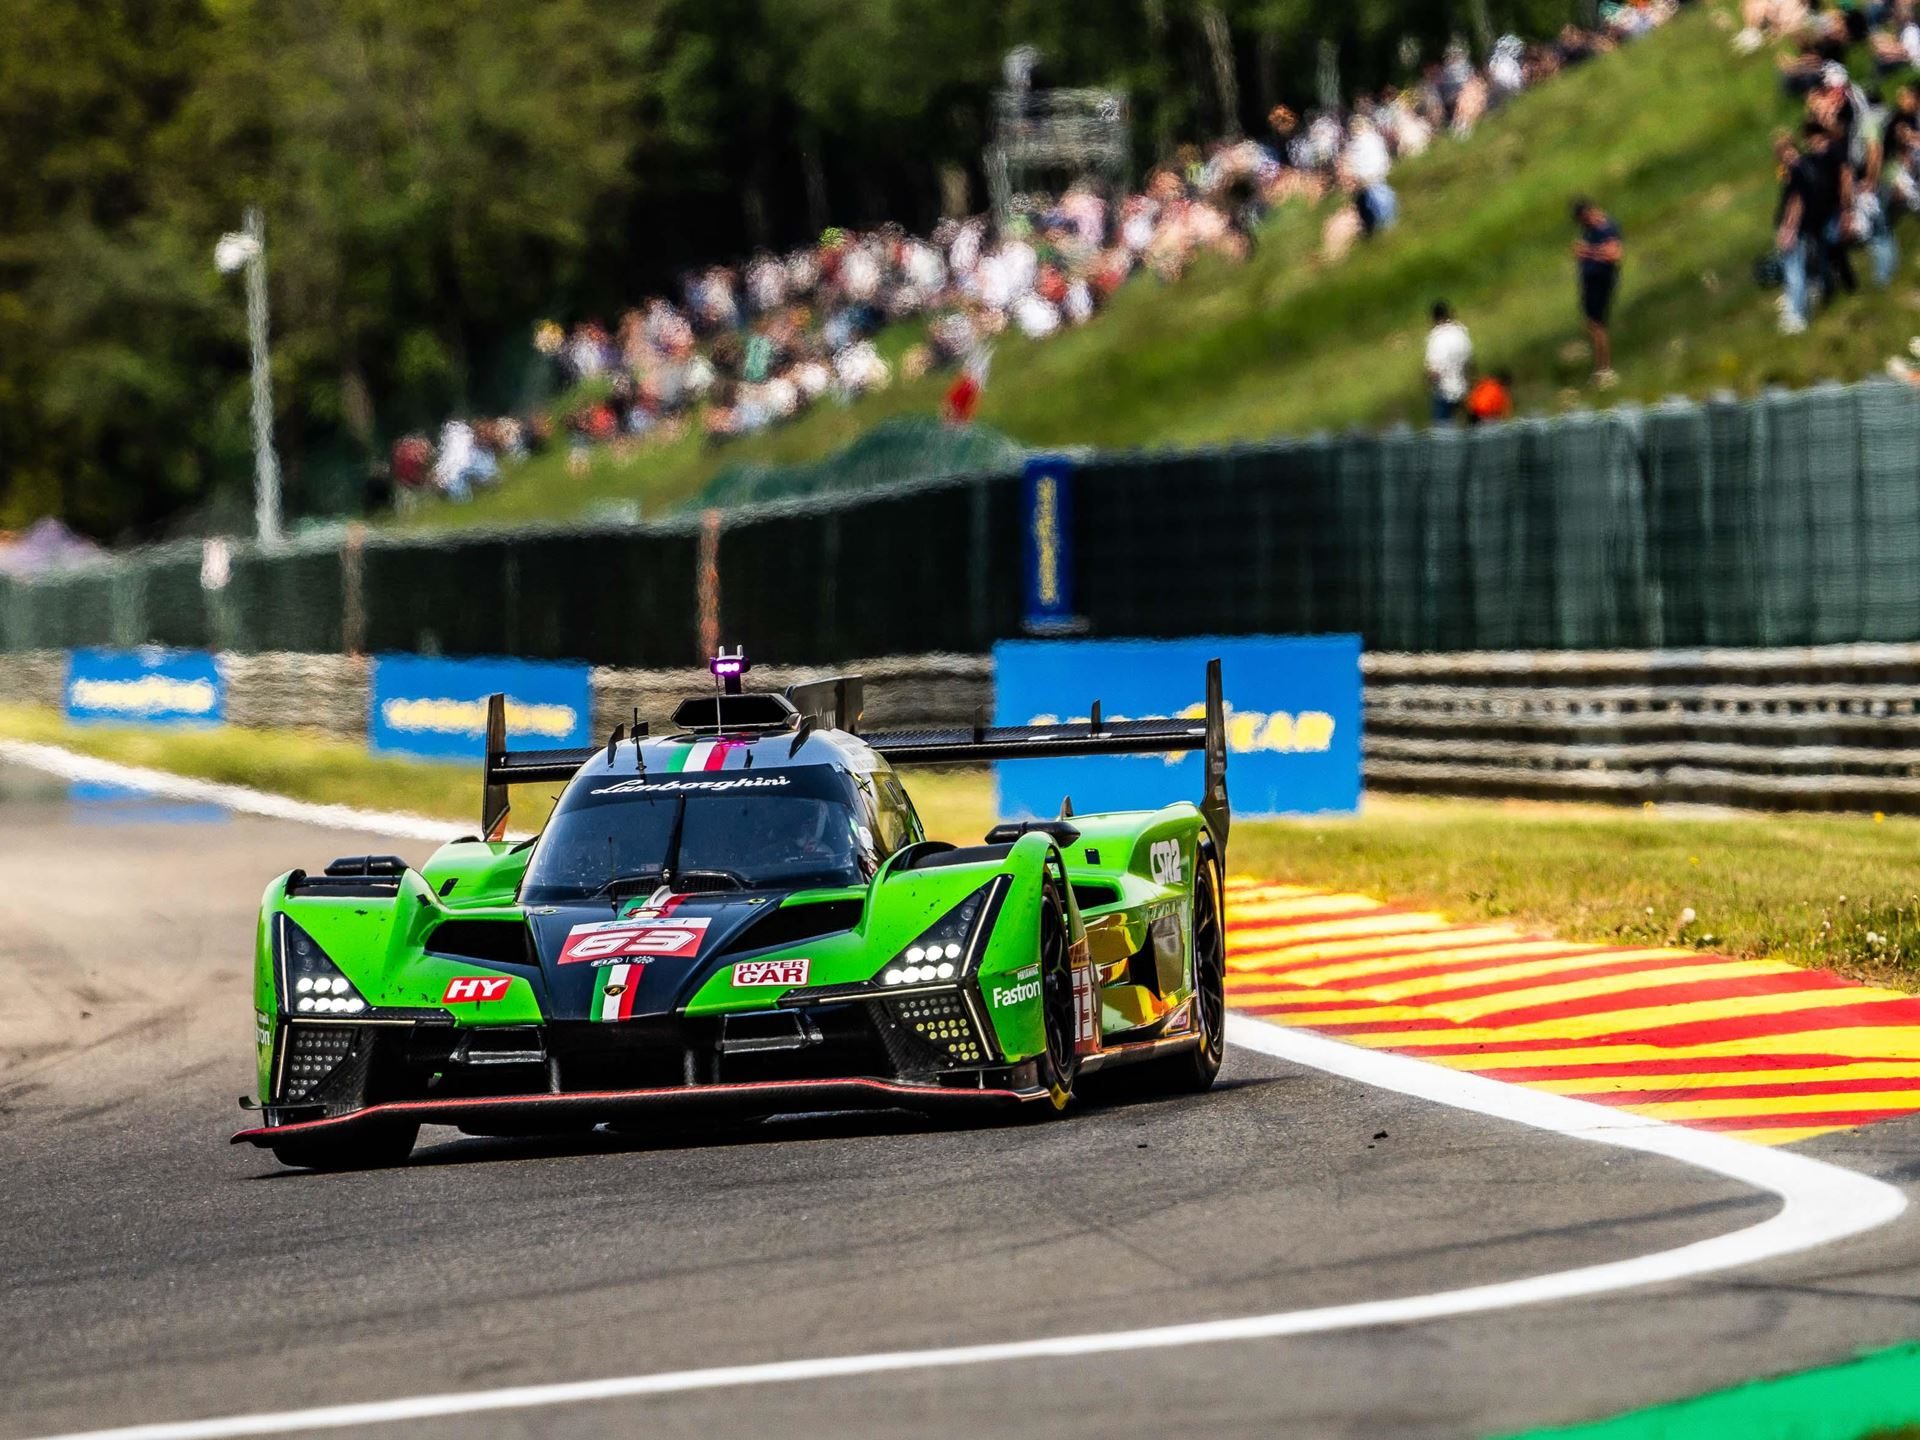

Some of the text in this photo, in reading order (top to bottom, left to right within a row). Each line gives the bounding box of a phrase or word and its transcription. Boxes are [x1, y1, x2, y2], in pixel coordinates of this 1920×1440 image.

[591, 776, 790, 794] Lamborghini
[567, 930, 697, 958] 63
[739, 961, 804, 971] HYPER
[738, 968, 803, 984] CAR
[447, 980, 509, 998] HY
[993, 981, 1040, 1008] Fastron
